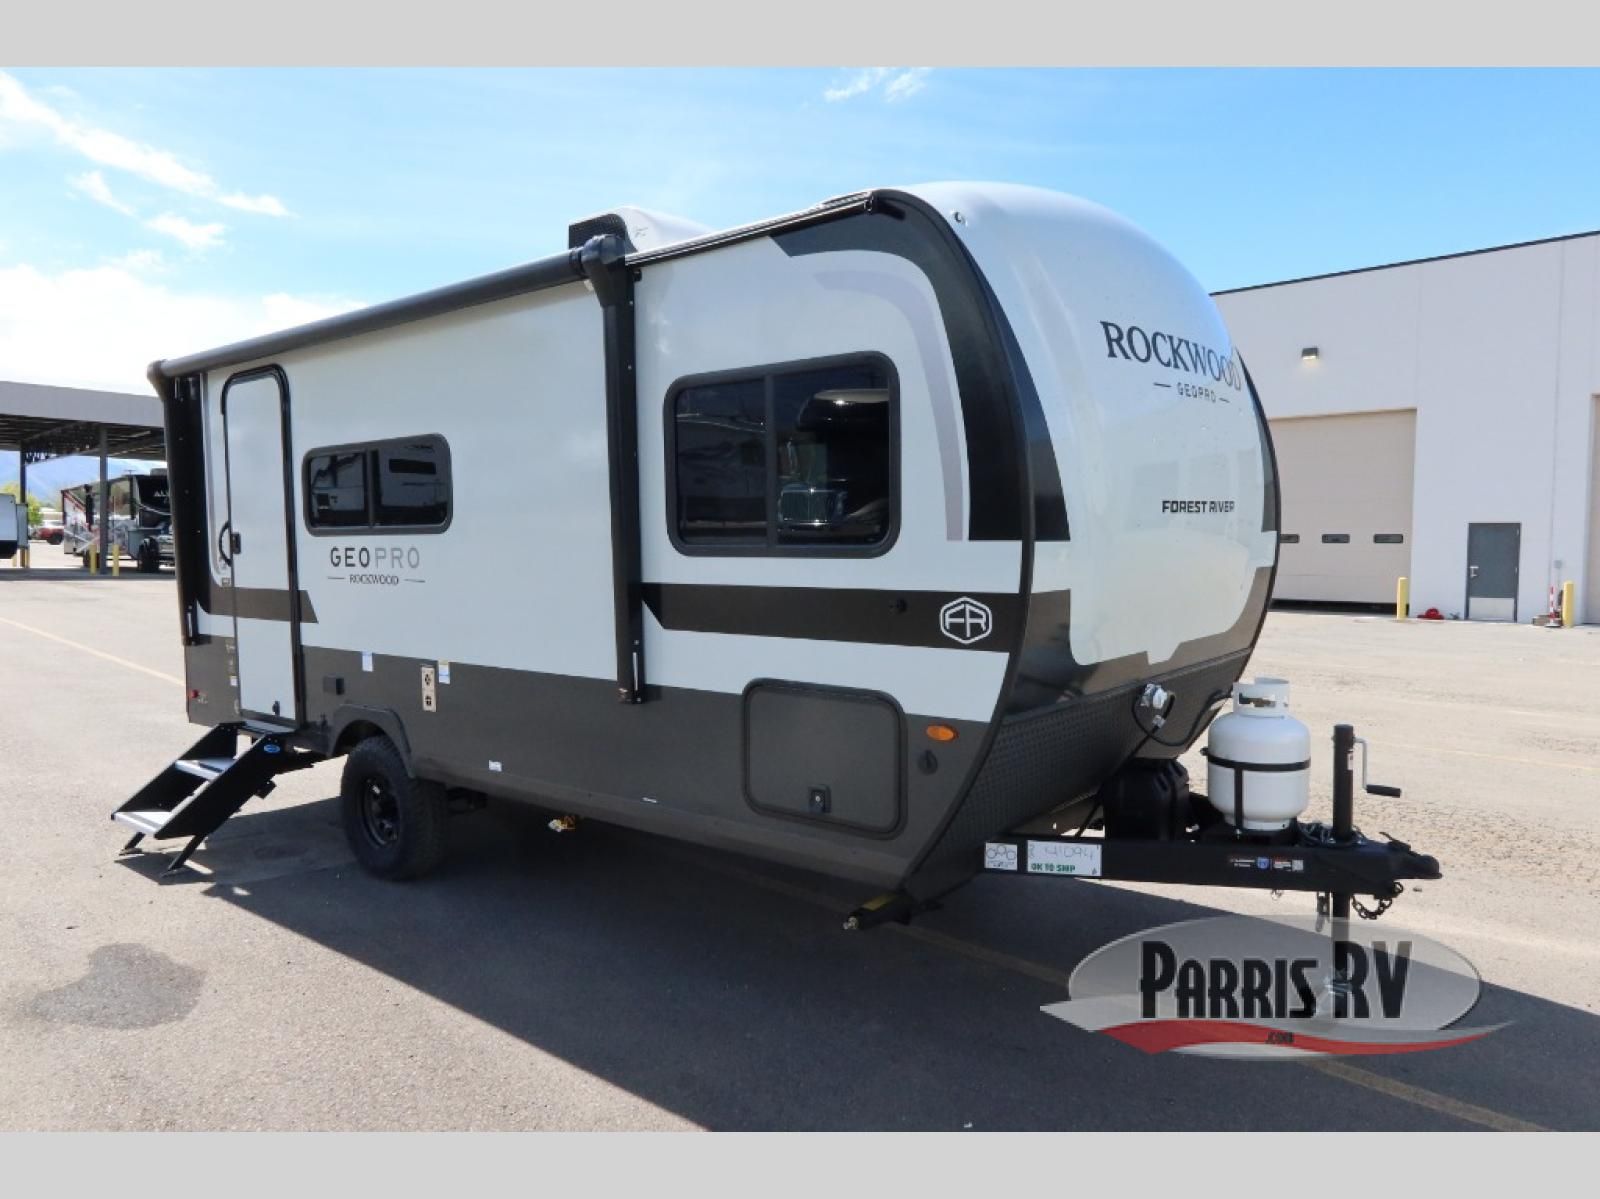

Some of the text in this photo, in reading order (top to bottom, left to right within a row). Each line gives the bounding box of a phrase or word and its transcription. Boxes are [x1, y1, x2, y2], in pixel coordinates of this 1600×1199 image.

[1099, 320, 1242, 391] ROCKWOOD
[1177, 382, 1217, 403] GEOPRO
[1162, 500, 1235, 513] FOREST RIVER
[330, 547, 420, 569] GEOPRO
[349, 574, 399, 585] ROCKWOOD
[1031, 862, 1076, 873] OK TO SHIP
